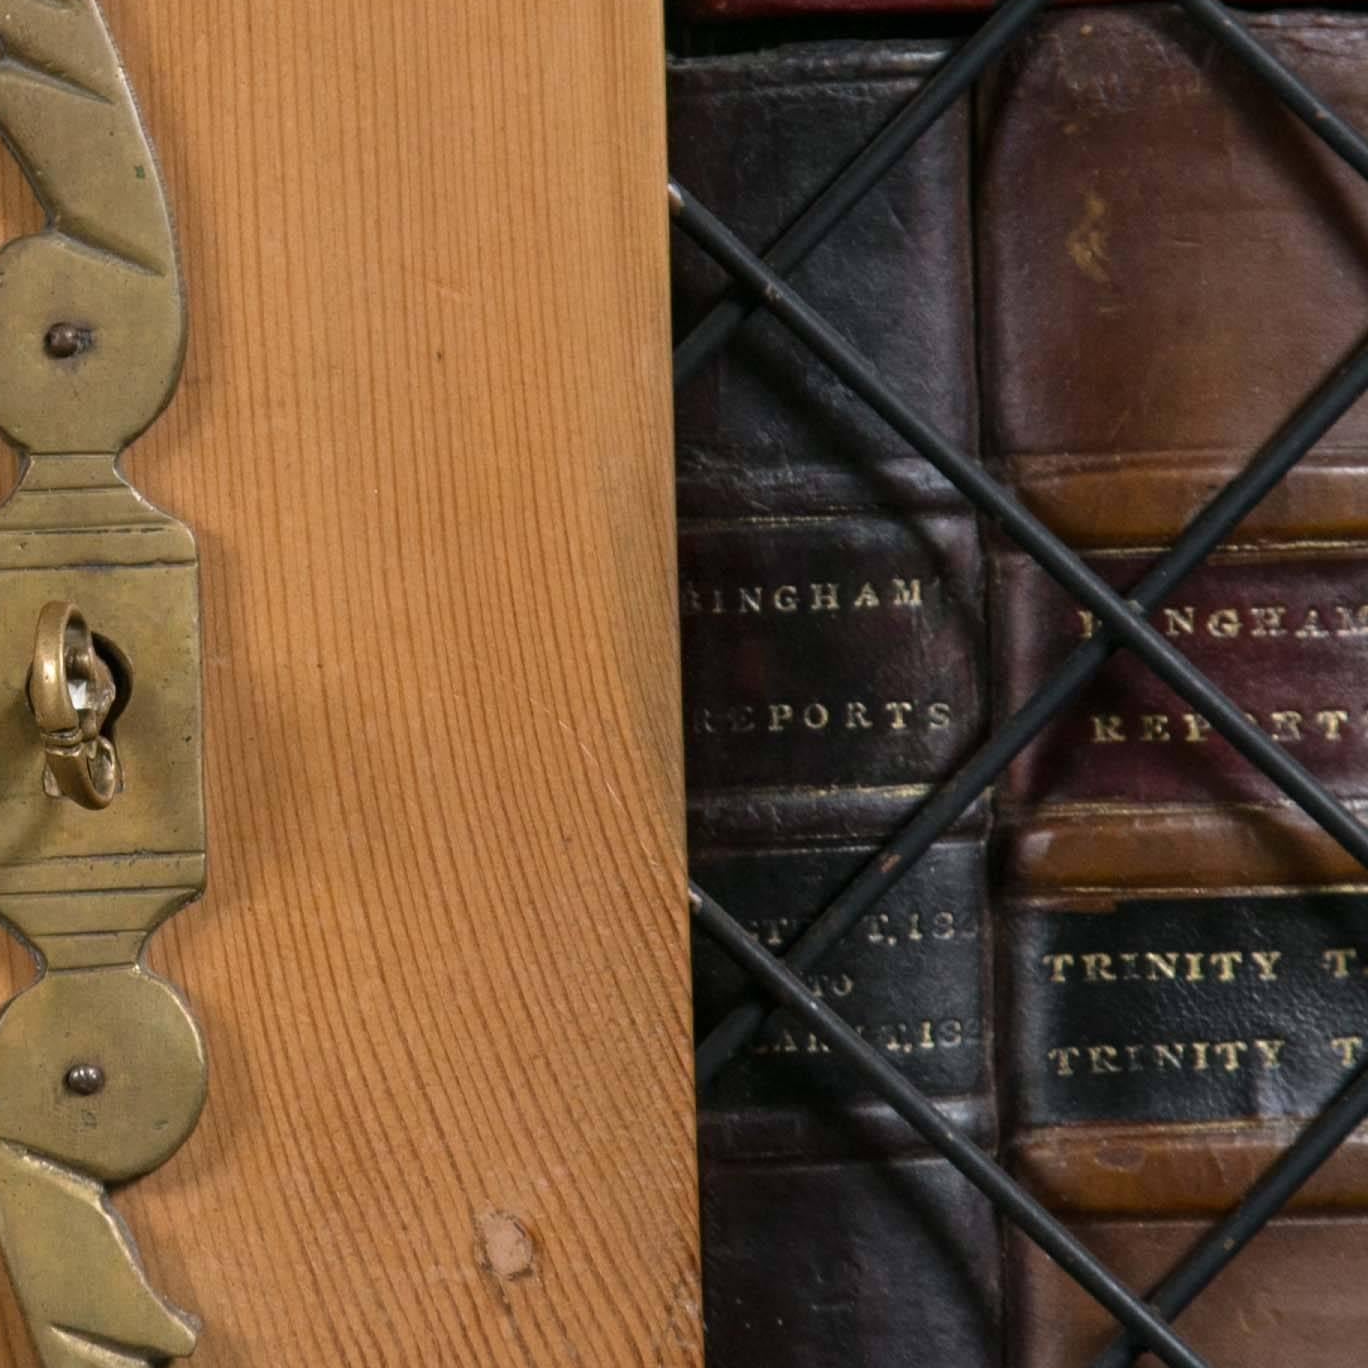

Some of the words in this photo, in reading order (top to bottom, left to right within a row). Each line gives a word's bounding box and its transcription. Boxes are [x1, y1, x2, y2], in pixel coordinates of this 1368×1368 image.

[1075, 605, 1368, 639] NGHAM
[1041, 949, 1282, 983] TRINITY
[1047, 1038, 1285, 1076] TRINITY
